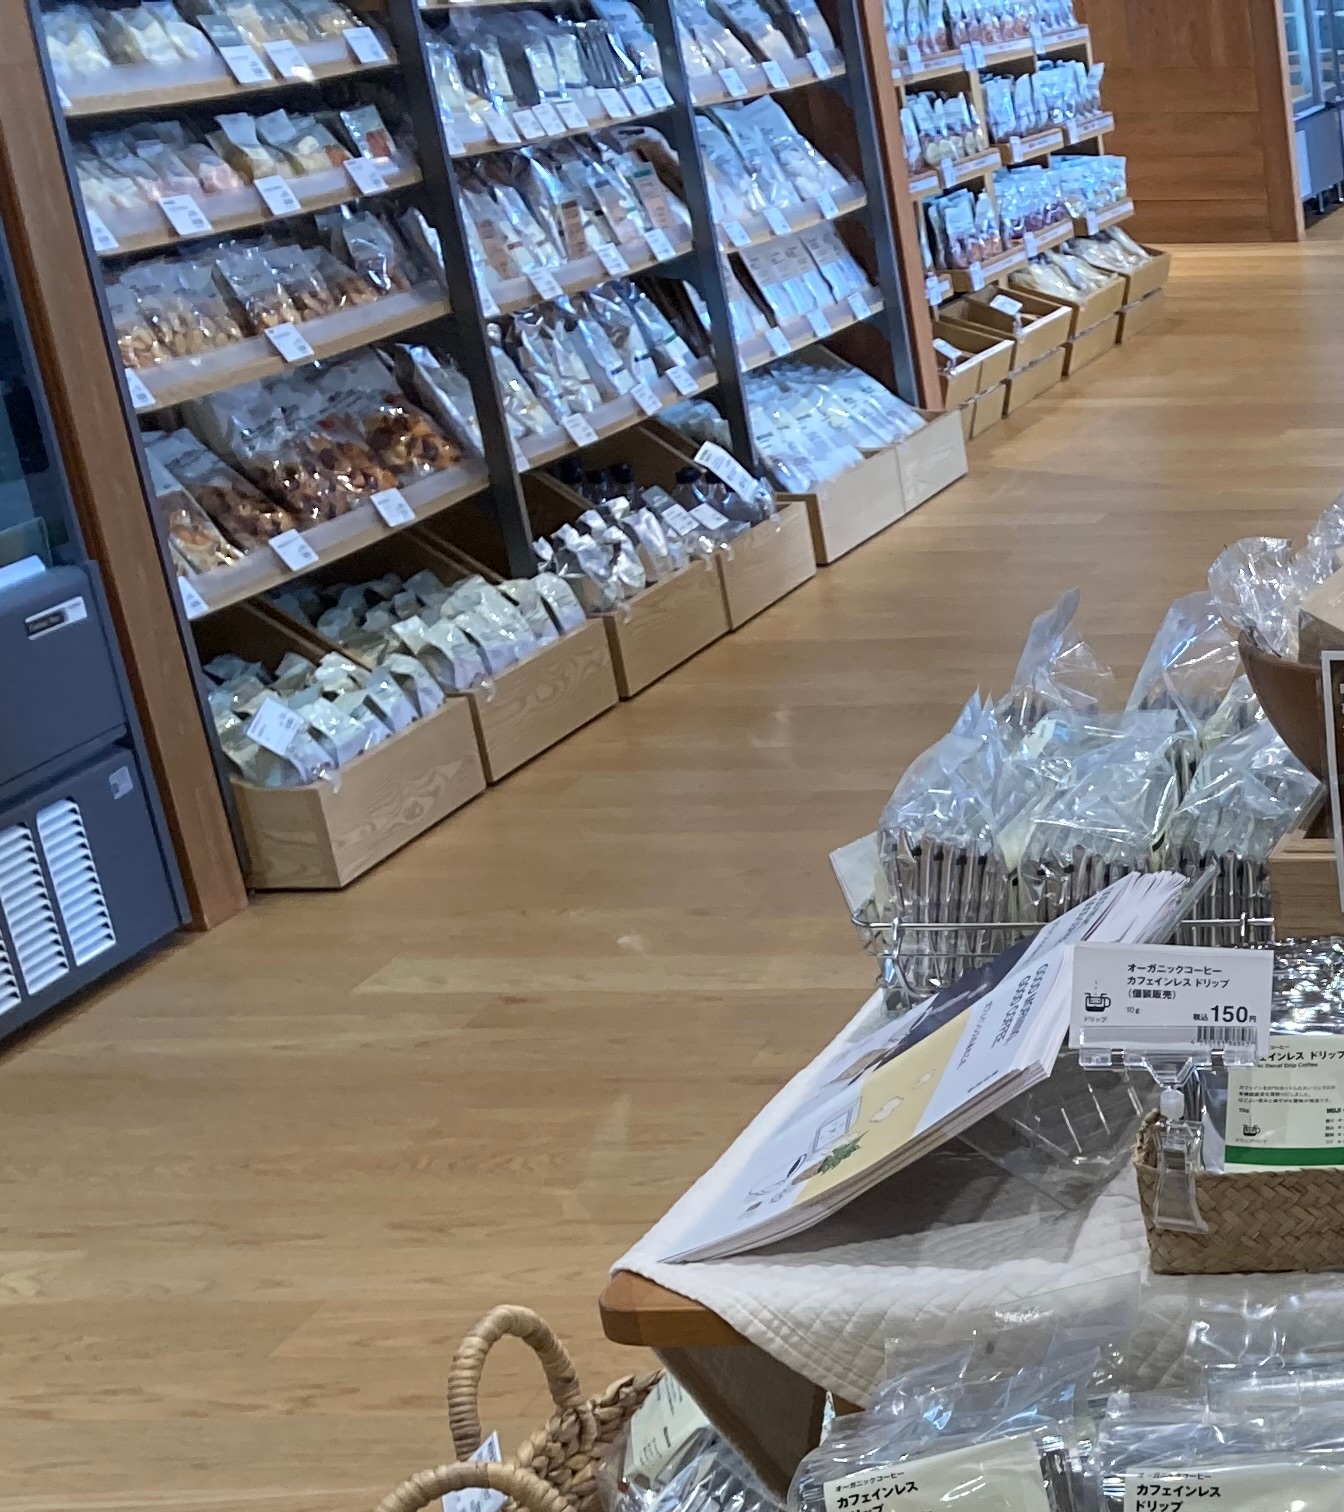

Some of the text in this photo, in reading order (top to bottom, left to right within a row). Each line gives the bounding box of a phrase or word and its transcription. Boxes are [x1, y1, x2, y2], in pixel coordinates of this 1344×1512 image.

[1127, 964, 1222, 975] オーガニックコーヒー
[1127, 976, 1229, 988] カフェインレス ドリップ
[837, 1481, 918, 1509] カフェインレス
[1136, 1484, 1221, 1497] カフェインレス
[1136, 1501, 1184, 1512] ドリップ
